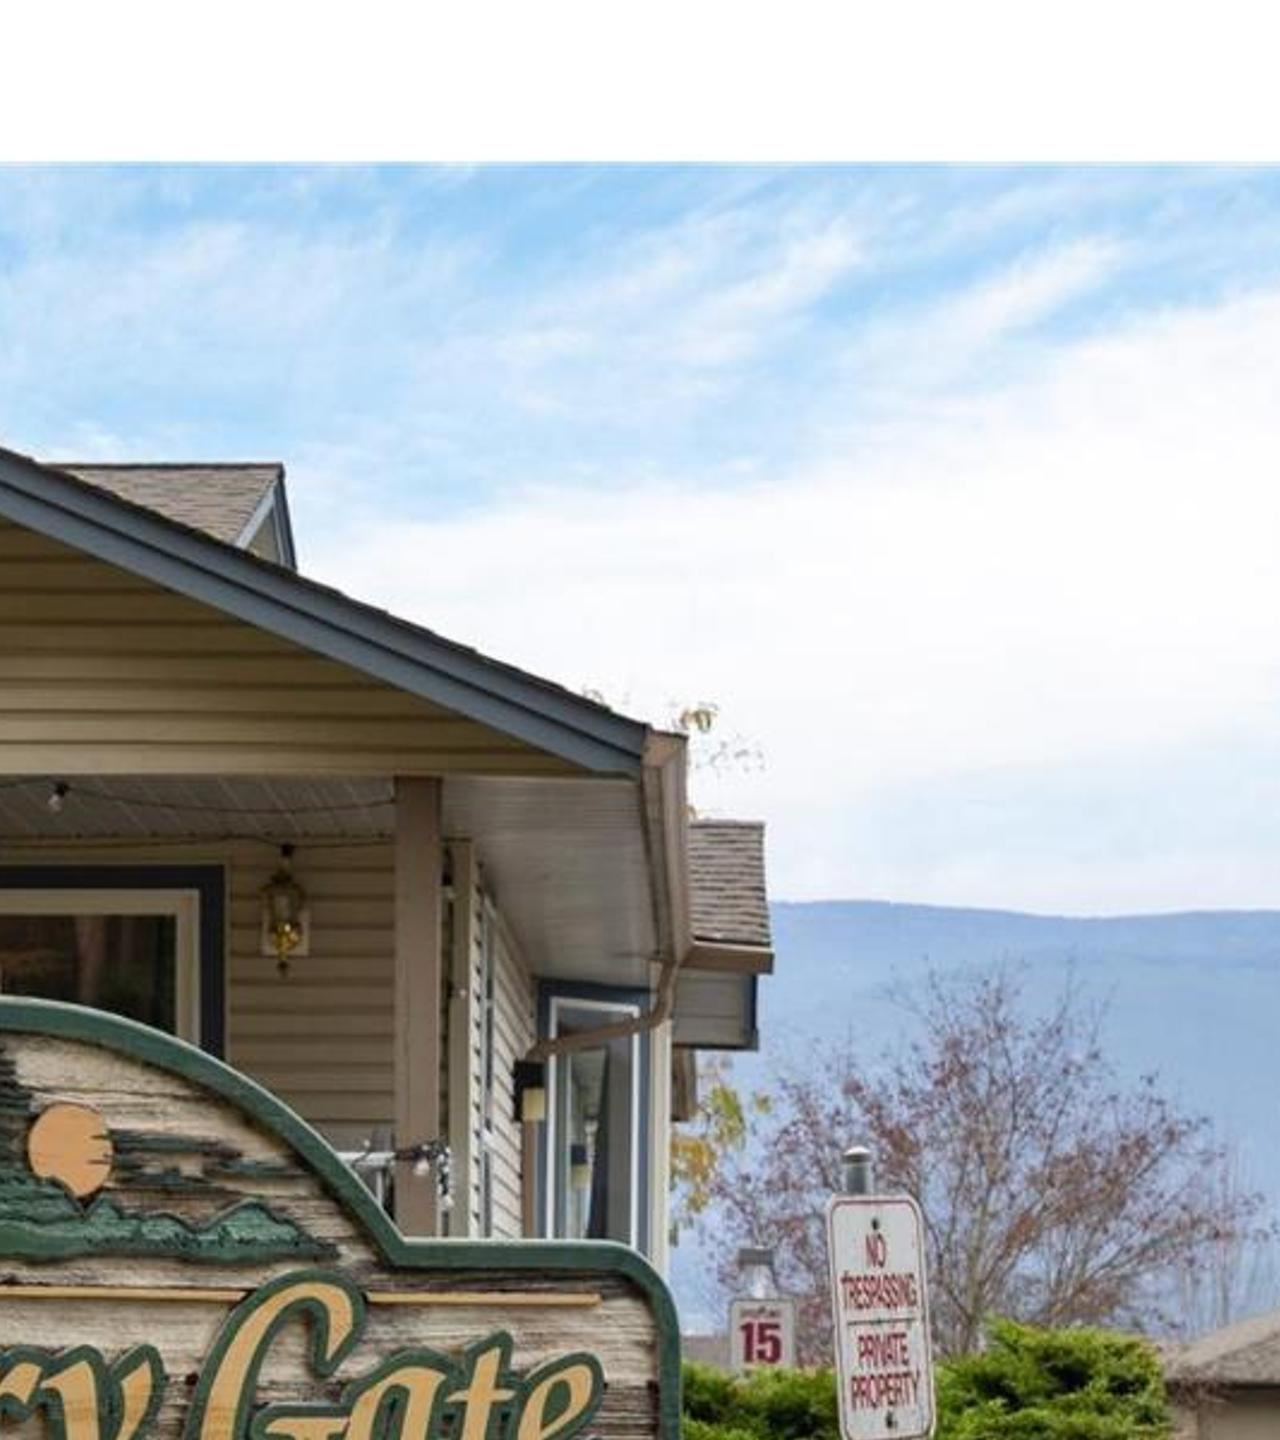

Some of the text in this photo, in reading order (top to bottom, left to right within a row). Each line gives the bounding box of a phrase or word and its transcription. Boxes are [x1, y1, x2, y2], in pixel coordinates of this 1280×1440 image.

[865, 1231, 887, 1268] NO
[840, 1271, 918, 1310] TRESPASSING
[740, 1321, 782, 1363] 15
[857, 1331, 910, 1369] PRIVATE
[851, 1367, 920, 1411] PROPERTY
